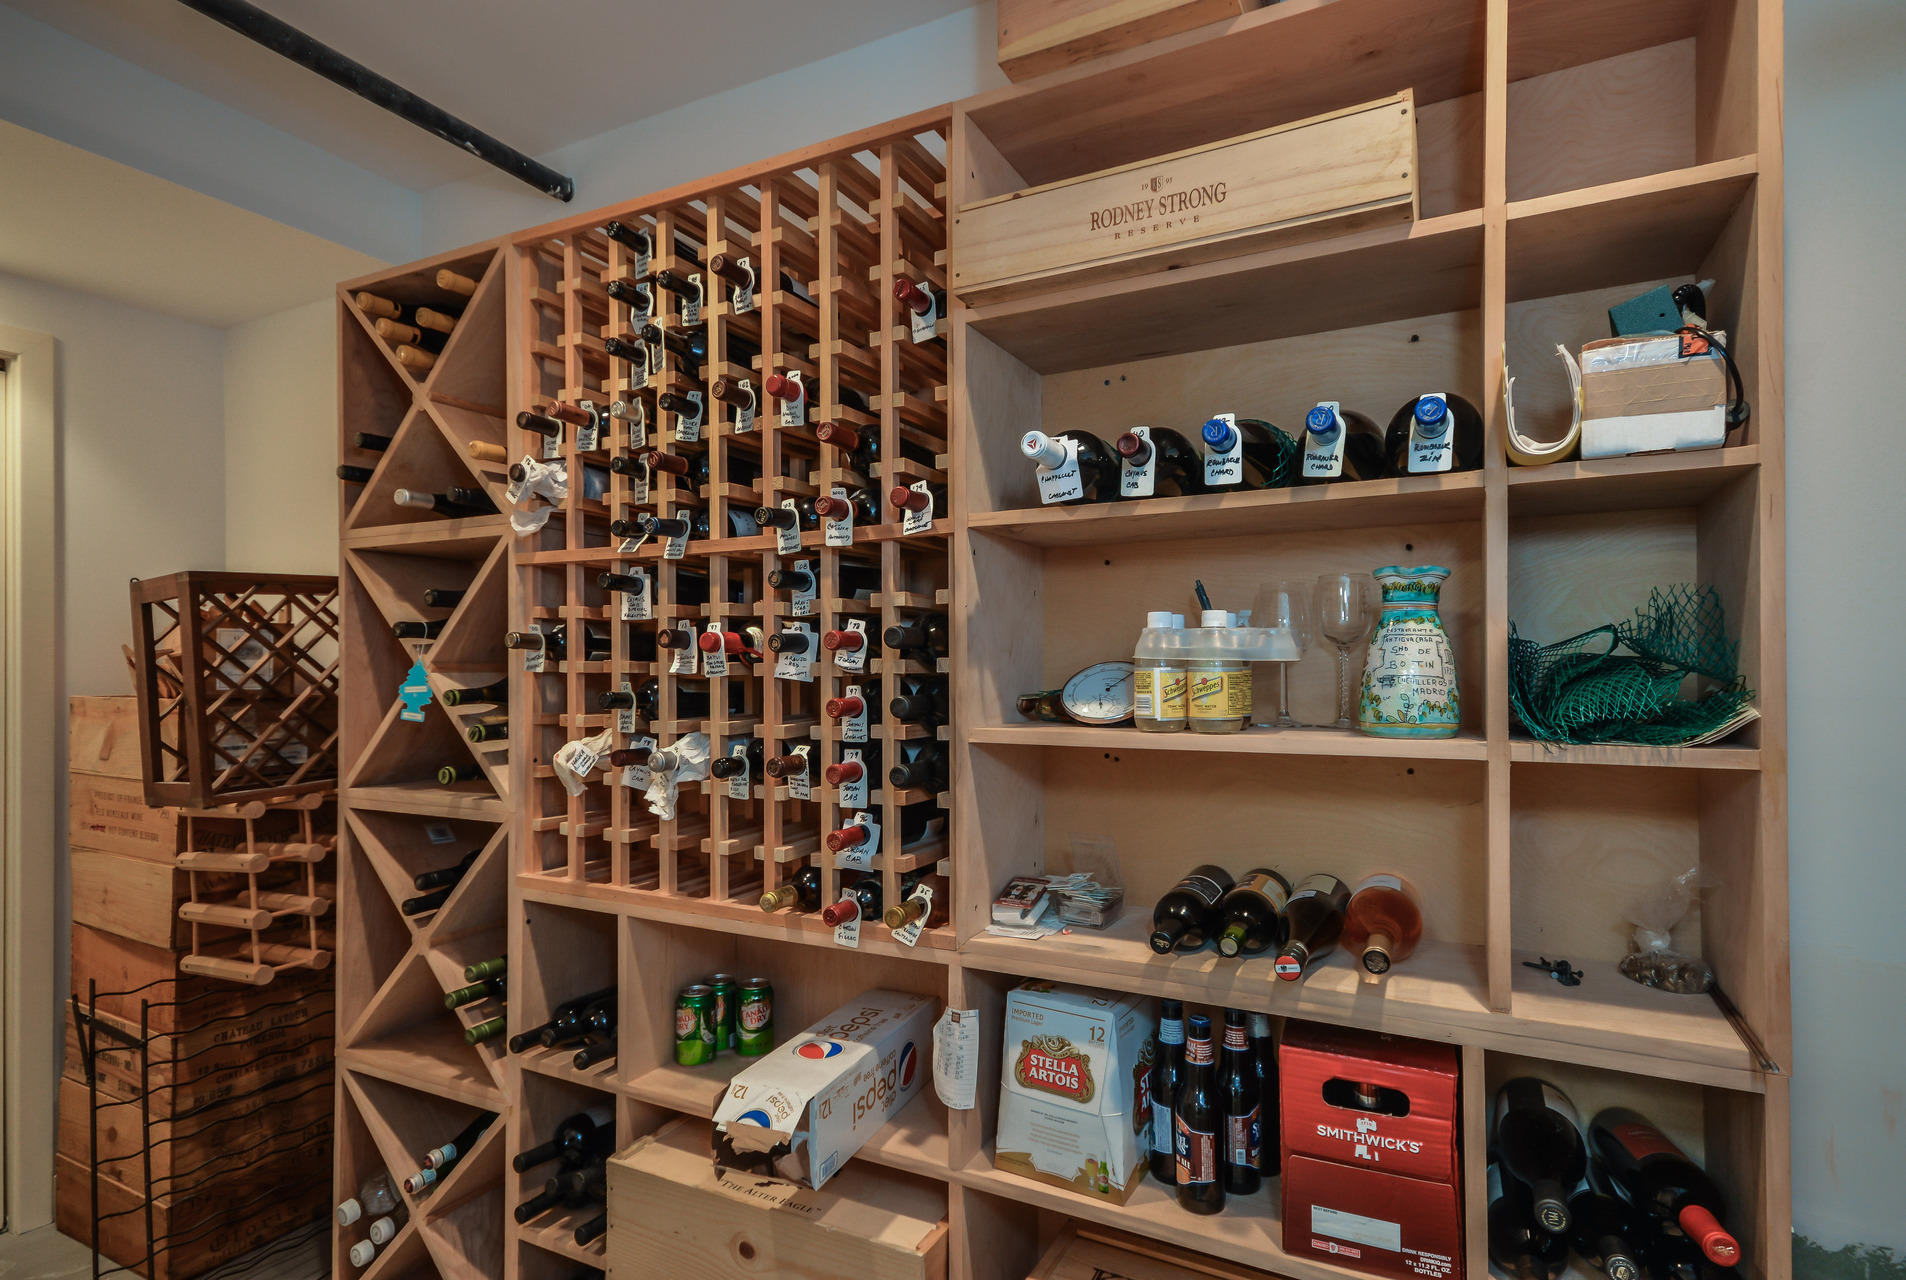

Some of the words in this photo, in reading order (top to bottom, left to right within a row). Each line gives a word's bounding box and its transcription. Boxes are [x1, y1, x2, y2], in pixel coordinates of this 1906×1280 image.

[1090, 199, 1155, 231] RODNEY
[1158, 182, 1227, 216] STRONG
[1114, 215, 1200, 240] RESERVE
[1126, 481, 1139, 489] CAB
[1192, 682, 1220, 697] Schweppes
[846, 856, 862, 864] CAB
[750, 1015, 766, 1025] DRY
[1010, 1007, 1044, 1020] IMPORTED
[829, 1007, 884, 1041] pepsi
[1089, 1025, 1105, 1043] 12
[1030, 1054, 1079, 1077] STELLA
[1028, 1067, 1079, 1090] ARTOIS
[852, 1059, 897, 1131] pepsi
[766, 1095, 791, 1120] pepsi
[1317, 1124, 1421, 1154] SMITHWICK'S
[744, 1187, 777, 1202] ALTER
[1417, 1249, 1452, 1262] RESPONSIBLY
[1414, 1267, 1442, 1279] BOTTLES
[1418, 1262, 1430, 1270] 11.2
